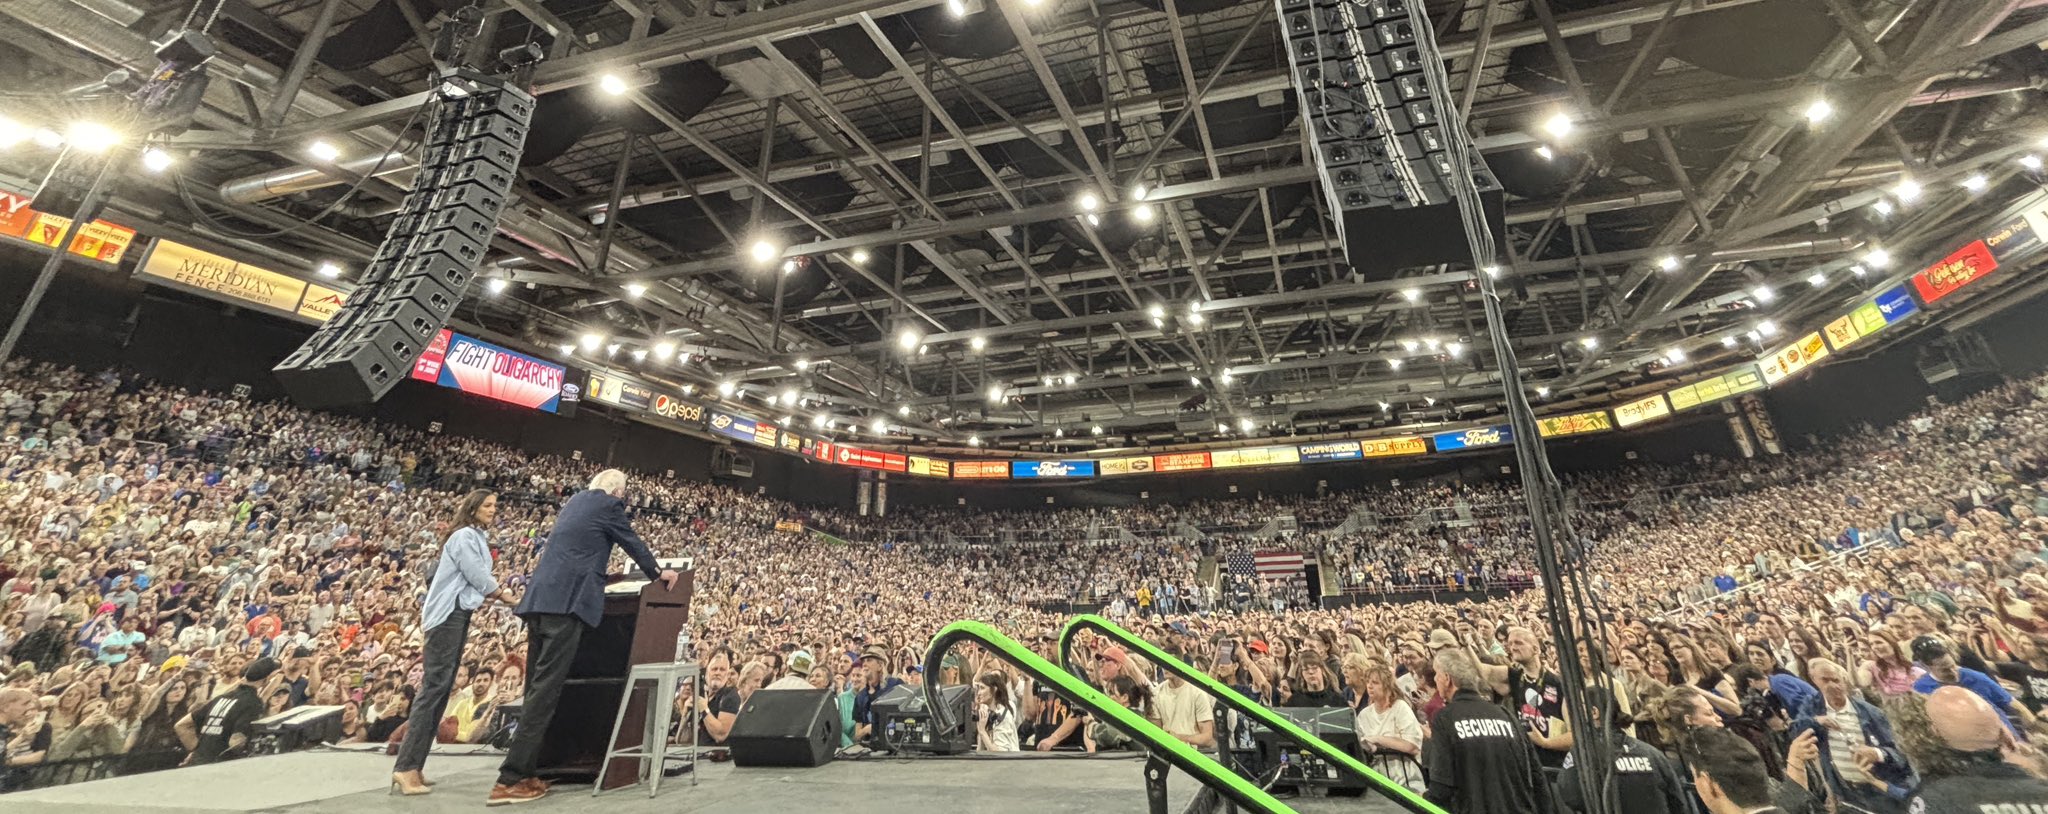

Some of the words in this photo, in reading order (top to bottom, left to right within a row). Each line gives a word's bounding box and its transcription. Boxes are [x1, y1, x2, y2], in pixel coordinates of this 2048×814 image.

[174, 272, 225, 293] FENCE
[178, 258, 278, 297] MERIDIAN
[446, 341, 495, 371] FIGHT
[491, 351, 563, 392] OLIGARCHY
[667, 401, 702, 421] pepsi
[1463, 428, 1500, 446] Ford
[1037, 461, 1068, 476] Ford
[1454, 718, 1514, 739] SECURITY
[1615, 756, 1653, 772] OLICE
